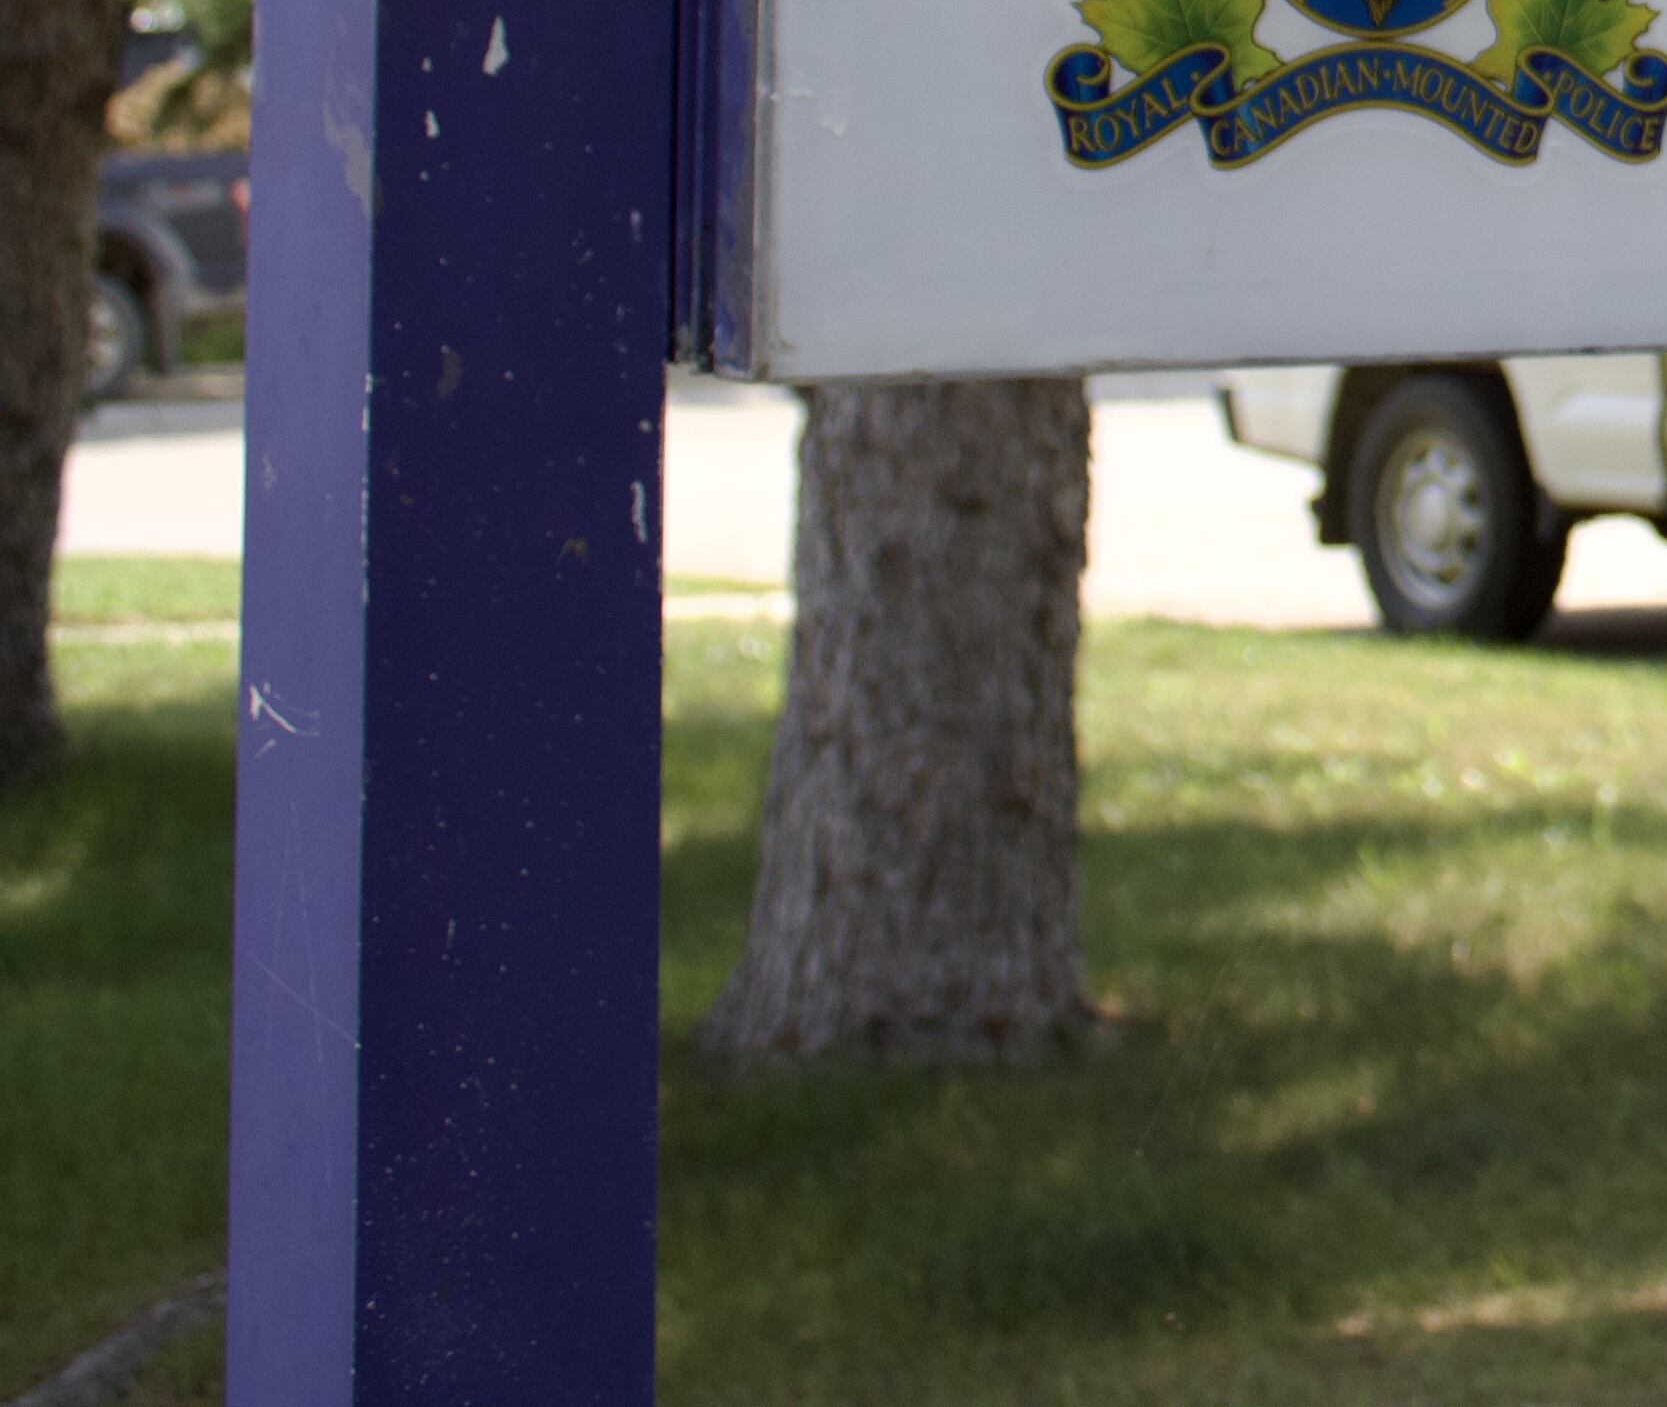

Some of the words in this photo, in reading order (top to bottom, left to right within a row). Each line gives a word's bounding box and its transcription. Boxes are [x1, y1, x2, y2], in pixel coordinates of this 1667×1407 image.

[1069, 89, 1184, 154] ROYAL
[1210, 56, 1379, 156] CANADIAN
[1393, 59, 1539, 155] MOUNTED
[1554, 71, 1661, 153] POLICE
